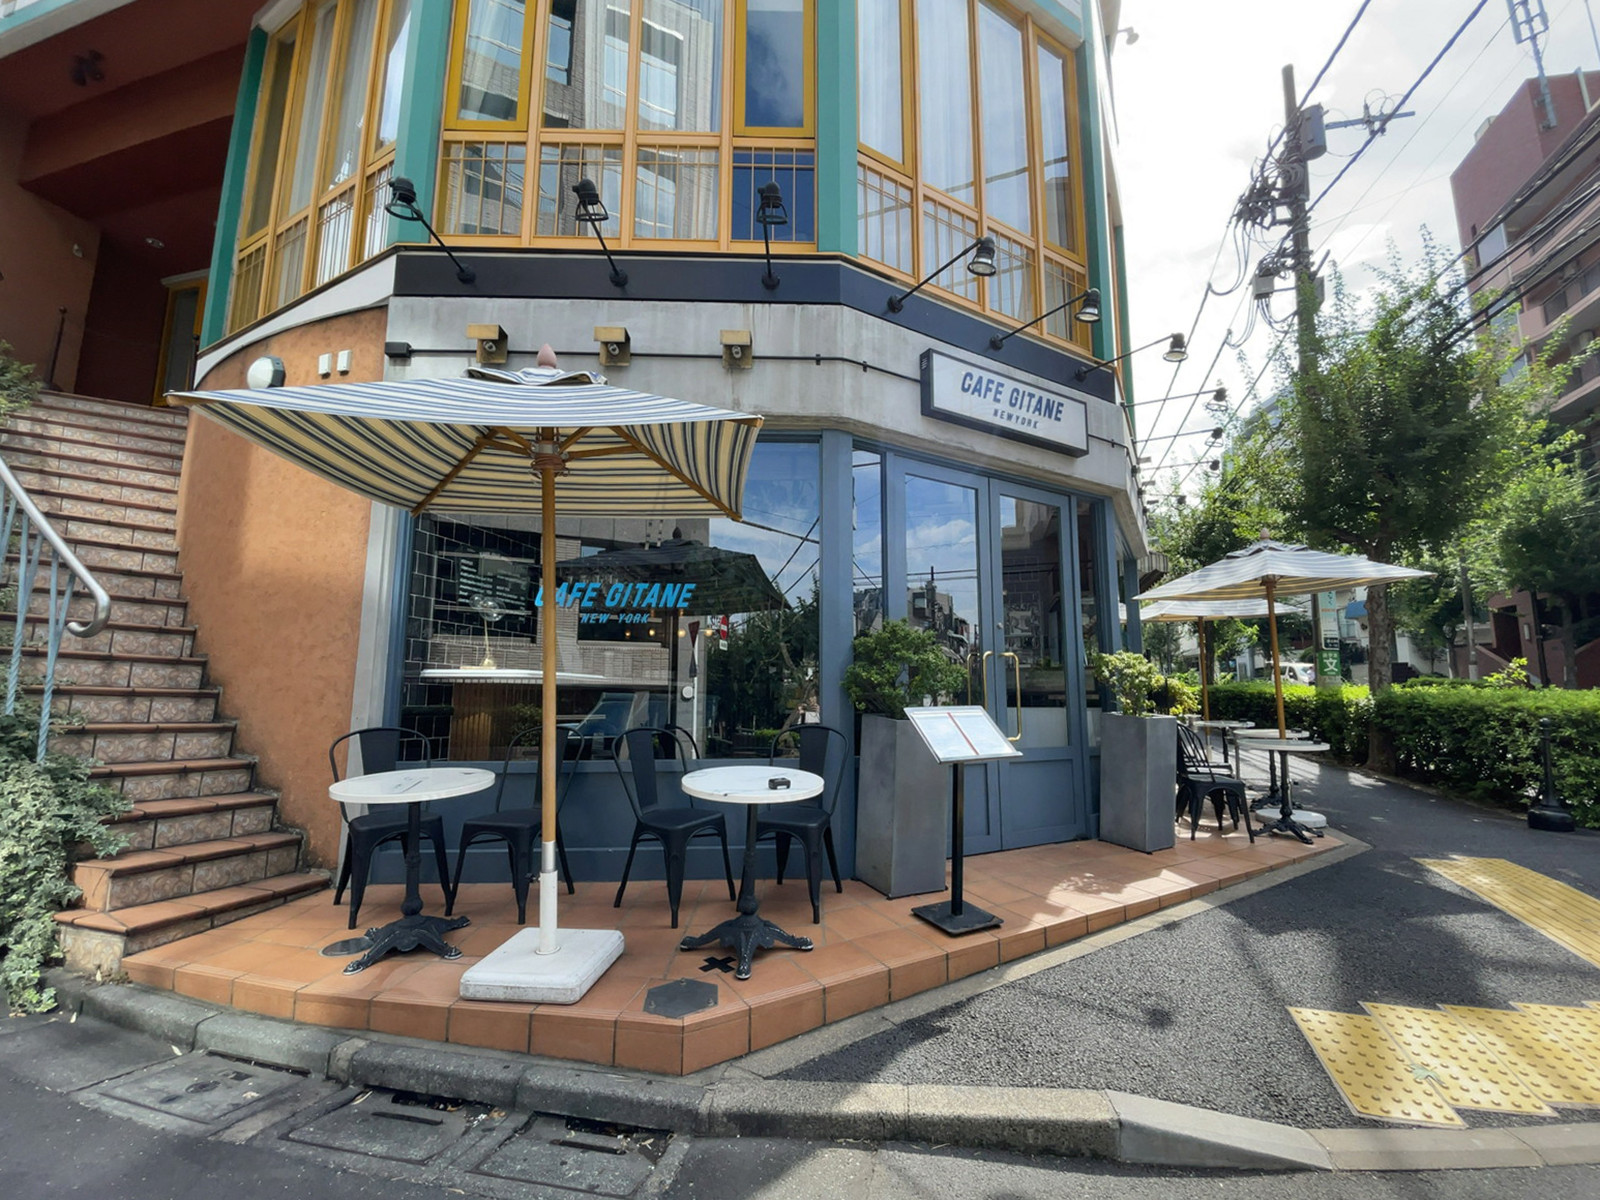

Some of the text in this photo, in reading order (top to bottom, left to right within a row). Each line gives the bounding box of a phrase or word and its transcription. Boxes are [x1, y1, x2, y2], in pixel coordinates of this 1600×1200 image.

[961, 372, 1064, 422] CAFE GITANE
[605, 583, 696, 608] GITANE
[580, 613, 650, 624] NEW YORK
[1323, 657, 1338, 672] 文
